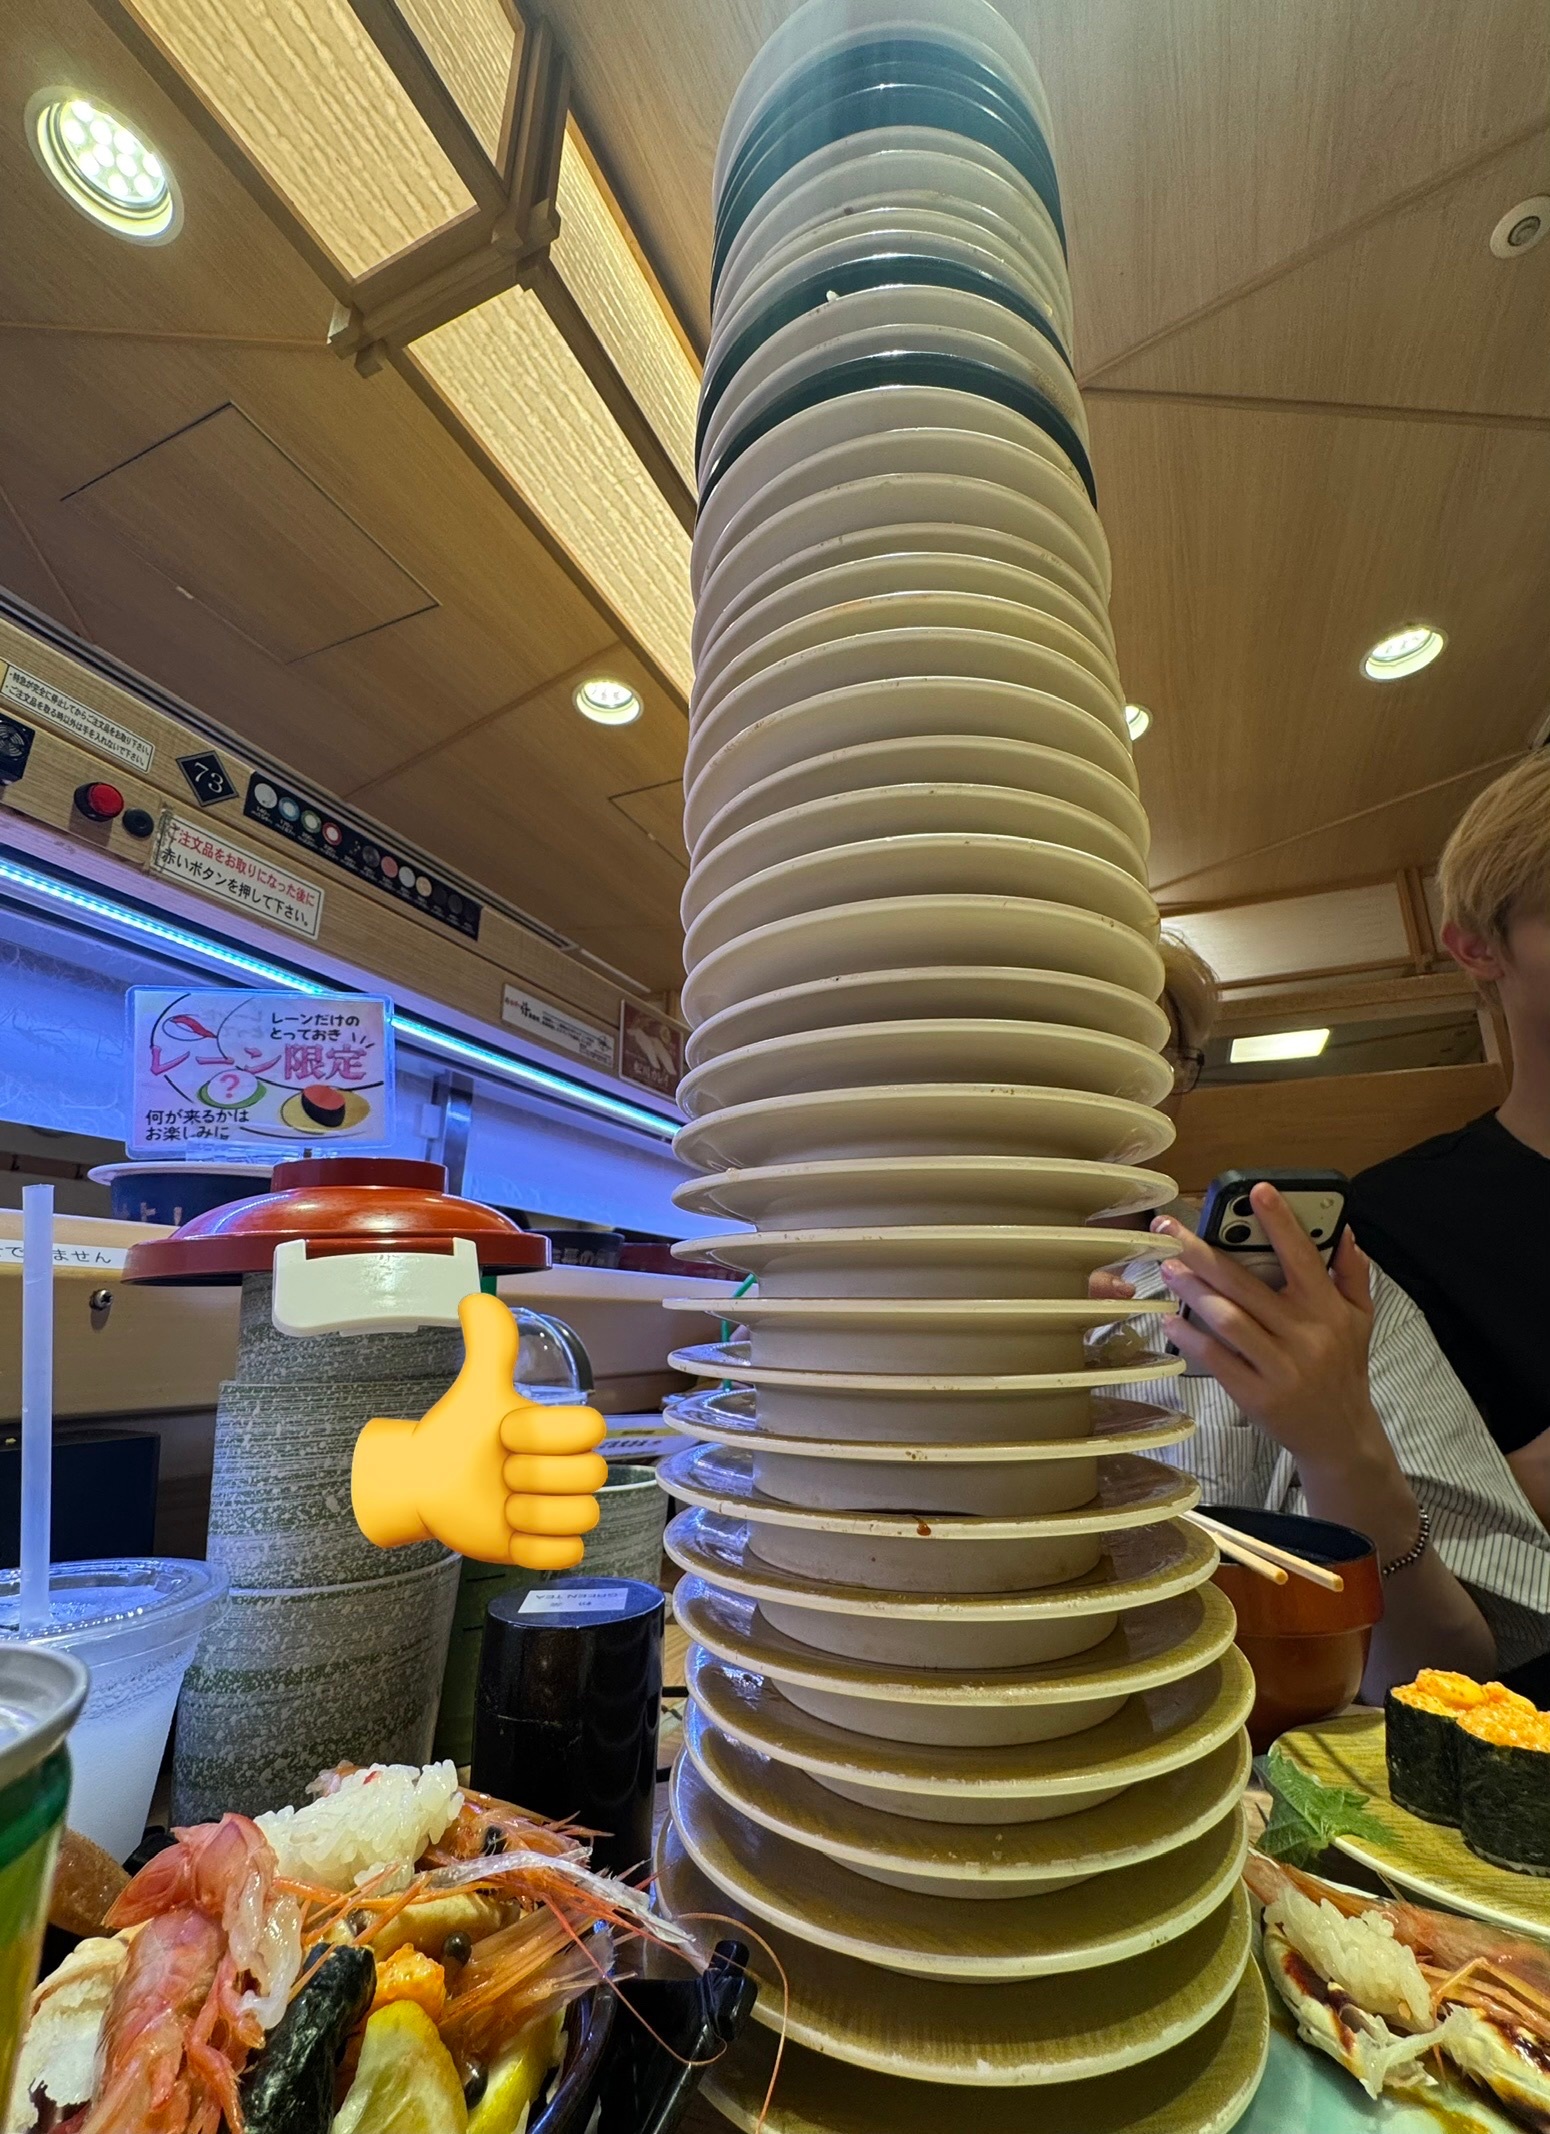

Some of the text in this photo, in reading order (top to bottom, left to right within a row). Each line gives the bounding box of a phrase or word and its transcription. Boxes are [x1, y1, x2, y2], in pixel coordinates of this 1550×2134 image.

[194, 762, 224, 793] 73
[161, 849, 308, 926] 赤いボタンを押して下さい。
[271, 1013, 360, 1027] レーンだけの
[270, 1028, 341, 1041] とっておき
[150, 1043, 367, 1081] レーン限定
[146, 1109, 249, 1126] 何が来るかは
[146, 1125, 230, 1140] お楽しみに
